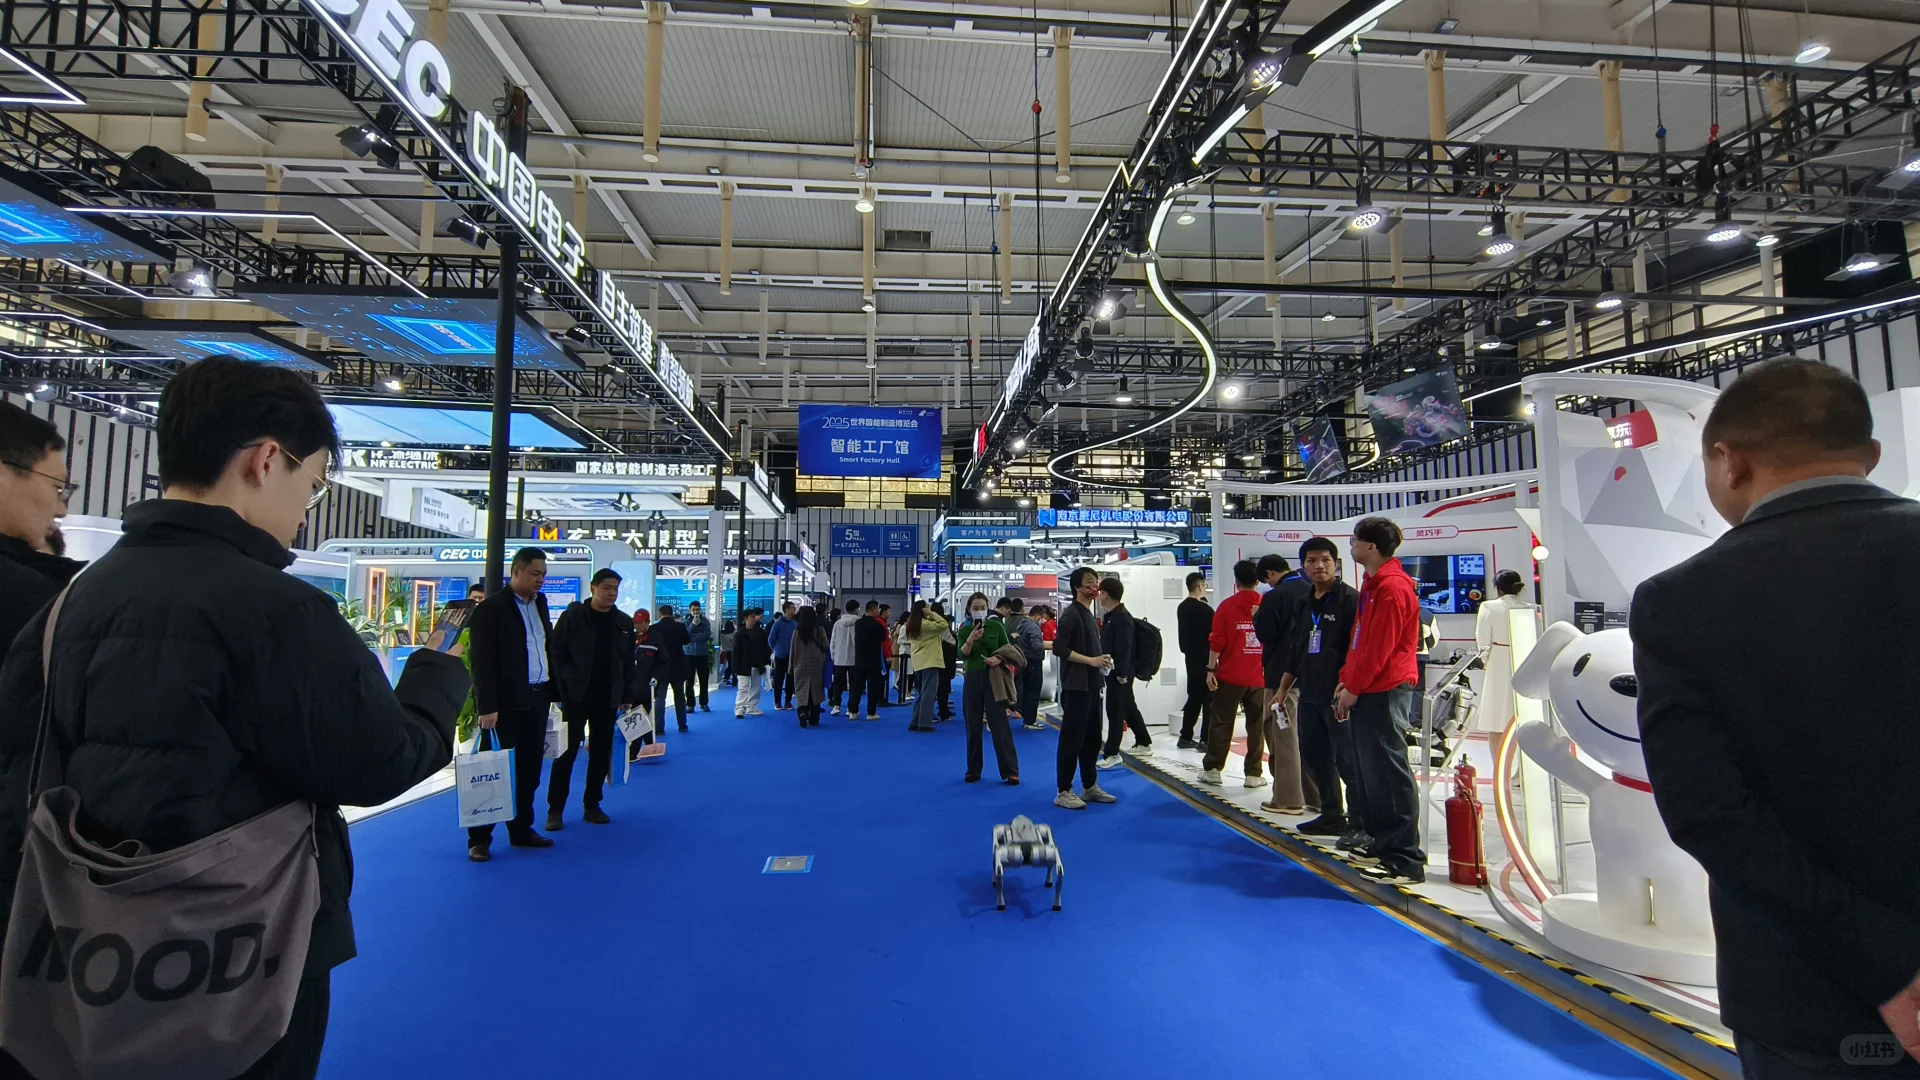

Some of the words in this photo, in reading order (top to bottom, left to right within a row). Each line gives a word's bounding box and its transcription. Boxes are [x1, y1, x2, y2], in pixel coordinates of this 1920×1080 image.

[470, 111, 585, 277] 中国电子
[602, 270, 653, 365] 自主筑基
[831, 438, 909, 455] 智能工厂馆
[388, 460, 440, 470] ELECTRIC
[860, 457, 885, 465] Factory
[575, 461, 717, 476] 国家级智能制造示范工厂
[1057, 509, 1188, 522] 南京康尼机电股份有限公司
[1416, 529, 1442, 537] 灵巧手
[440, 548, 469, 560] CEC
[566, 547, 589, 555] XUAN
